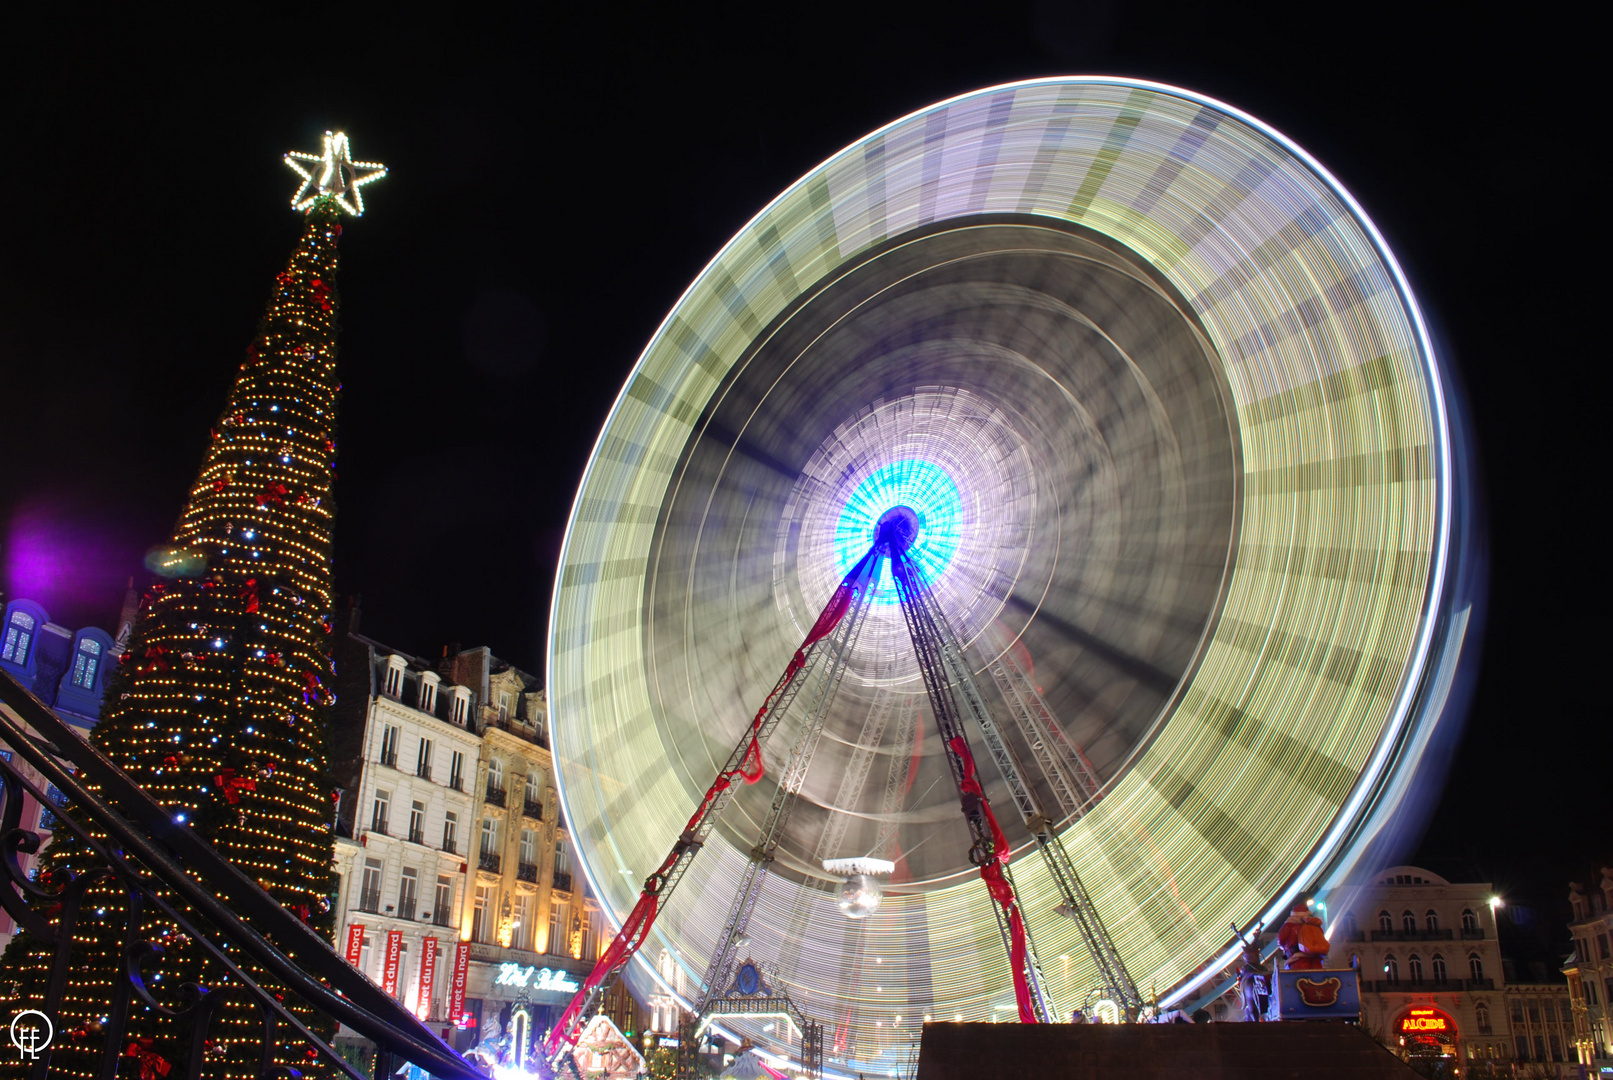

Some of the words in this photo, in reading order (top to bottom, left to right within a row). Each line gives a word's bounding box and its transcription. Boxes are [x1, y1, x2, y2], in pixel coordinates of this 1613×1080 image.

[351, 928, 361, 956] nord
[390, 934, 400, 961] nord
[425, 940, 435, 966] nord
[458, 946, 468, 971] nord
[387, 965, 396, 979] du
[422, 969, 432, 984] du
[456, 973, 465, 987] du
[452, 989, 463, 1018] Furet
[1402, 1018, 1446, 1030] ALCIDE
